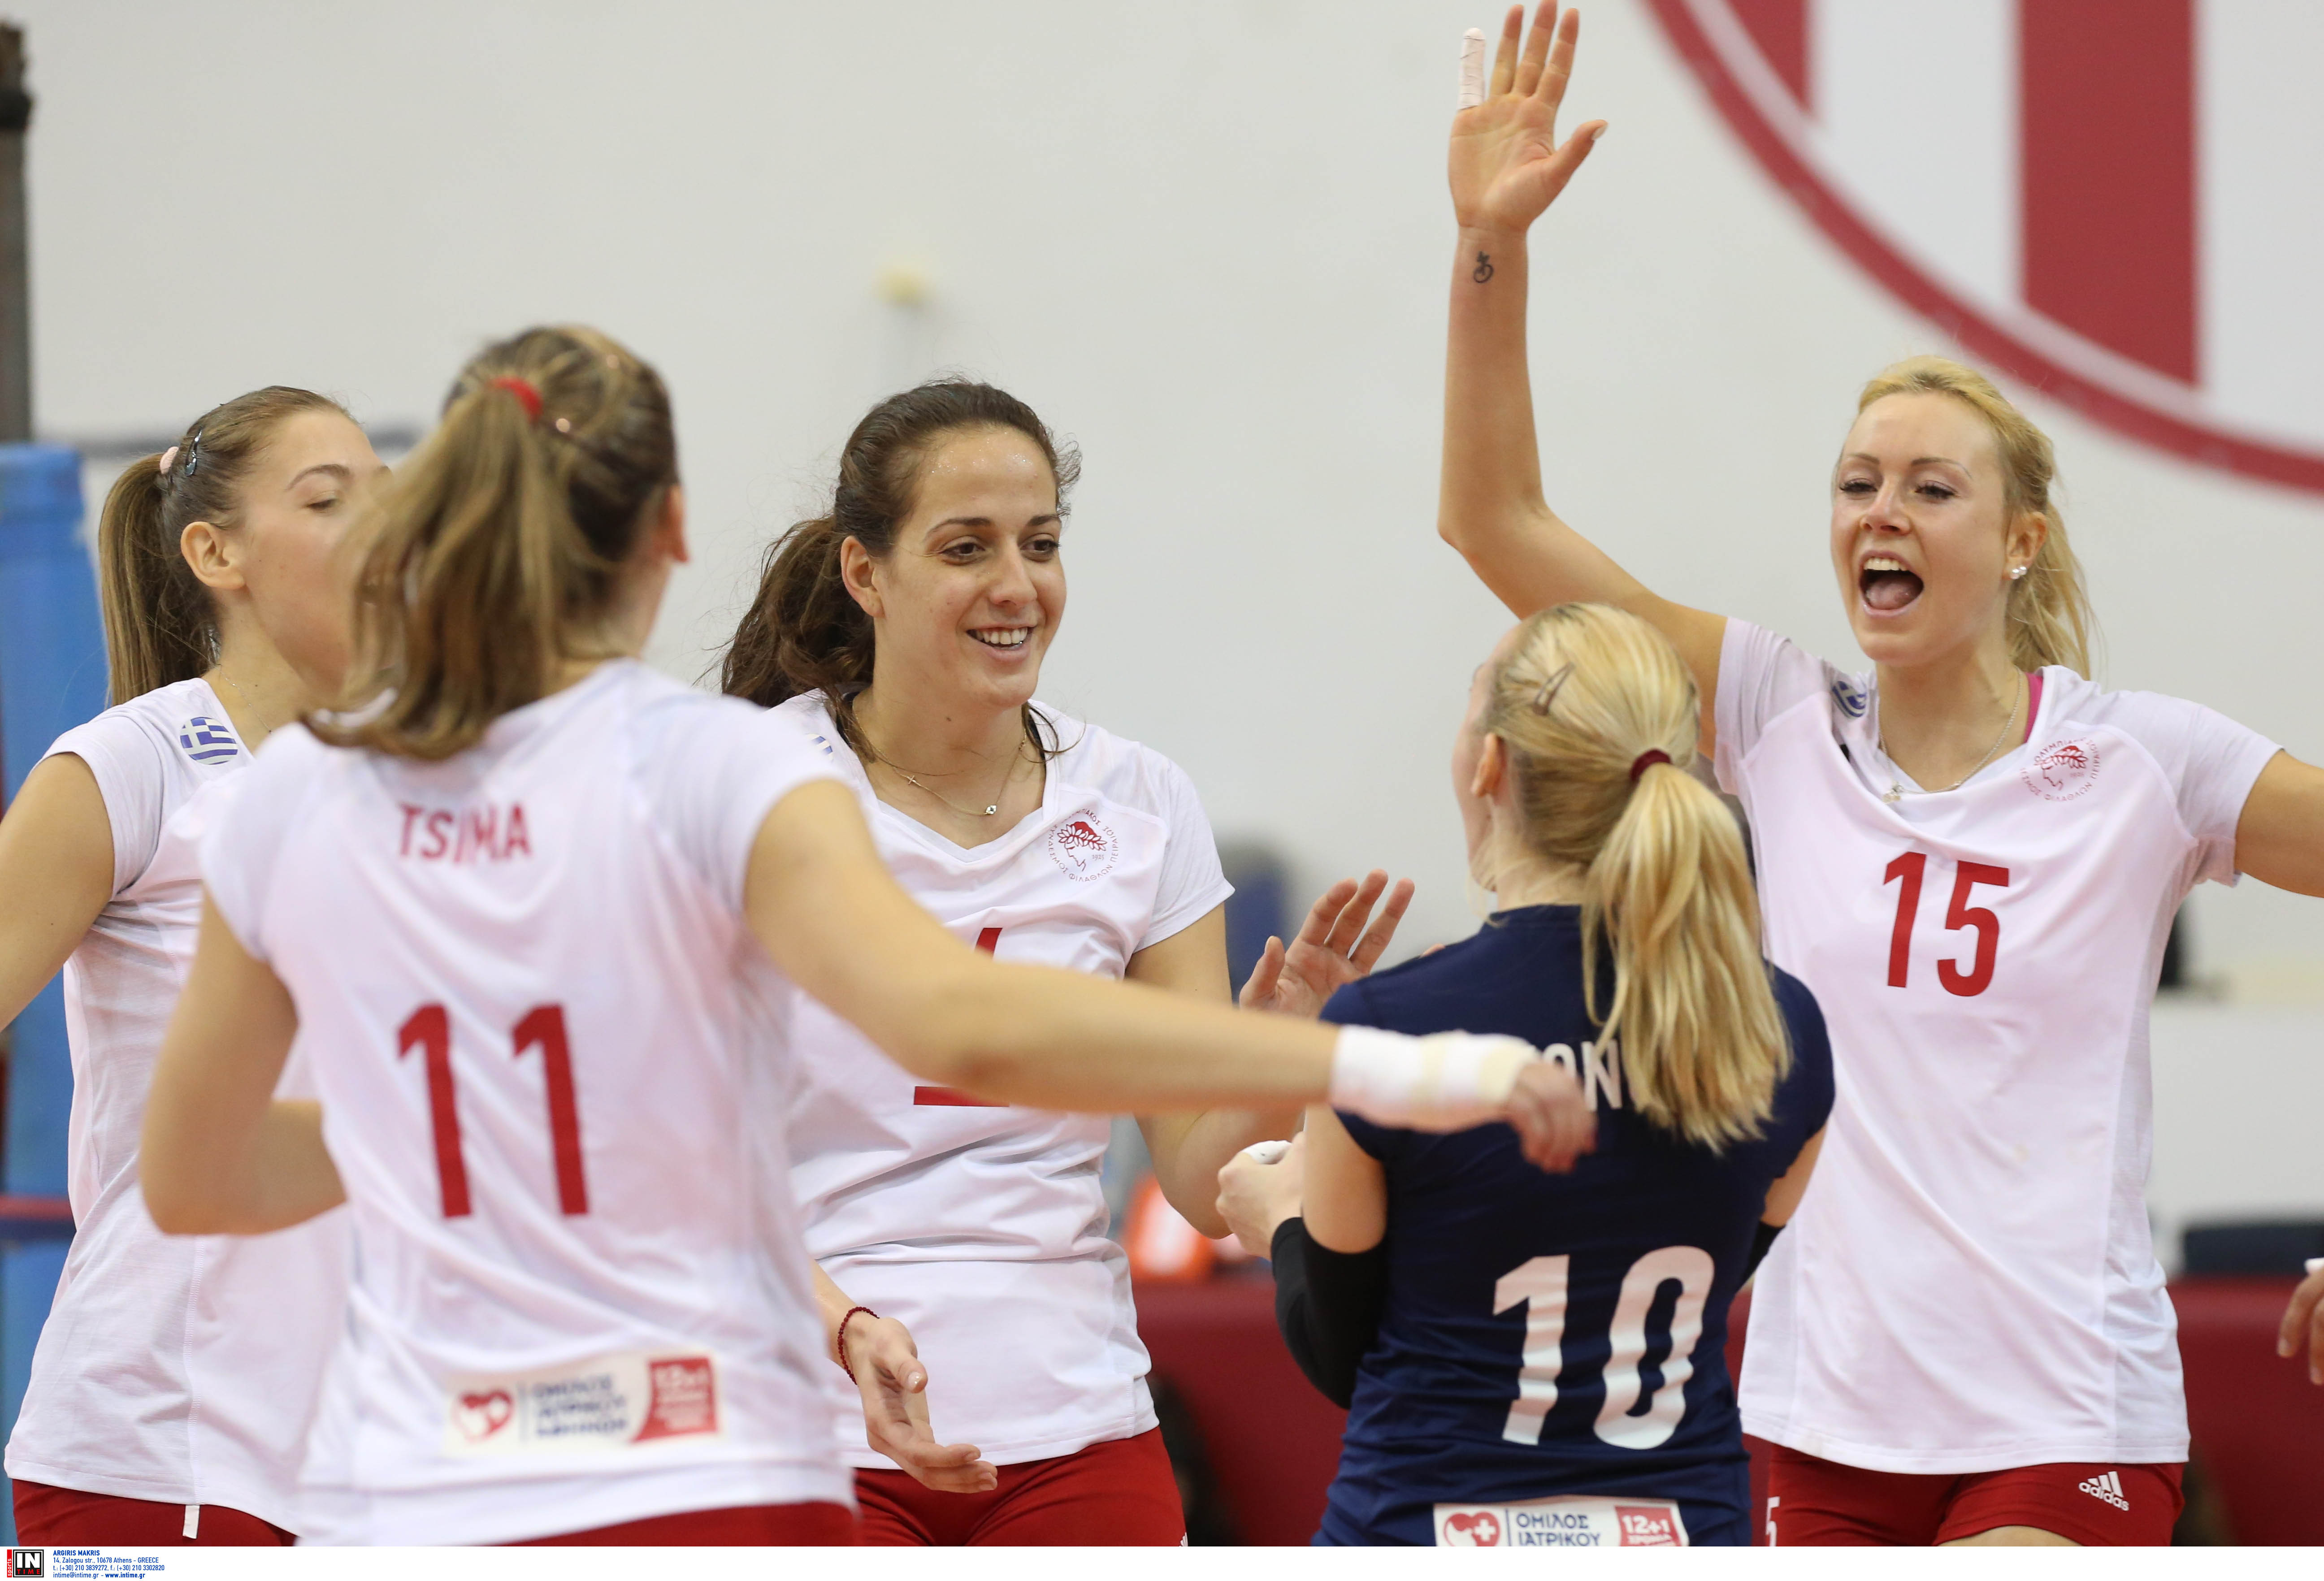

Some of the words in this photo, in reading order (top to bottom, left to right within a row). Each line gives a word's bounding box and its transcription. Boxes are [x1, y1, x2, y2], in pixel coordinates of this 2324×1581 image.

[1883, 851, 2009, 997] 15
[397, 1002, 590, 1220] 11
[1492, 1245, 1715, 1450] 10
[2078, 1482, 2129, 1512] adidas
[1516, 1513, 1589, 1529] ΟΜΙΛΟΣ
[1622, 1514, 1671, 1535] 12+1
[1518, 1531, 1600, 1546] ΙΑΤΡΙΚΟΥ
